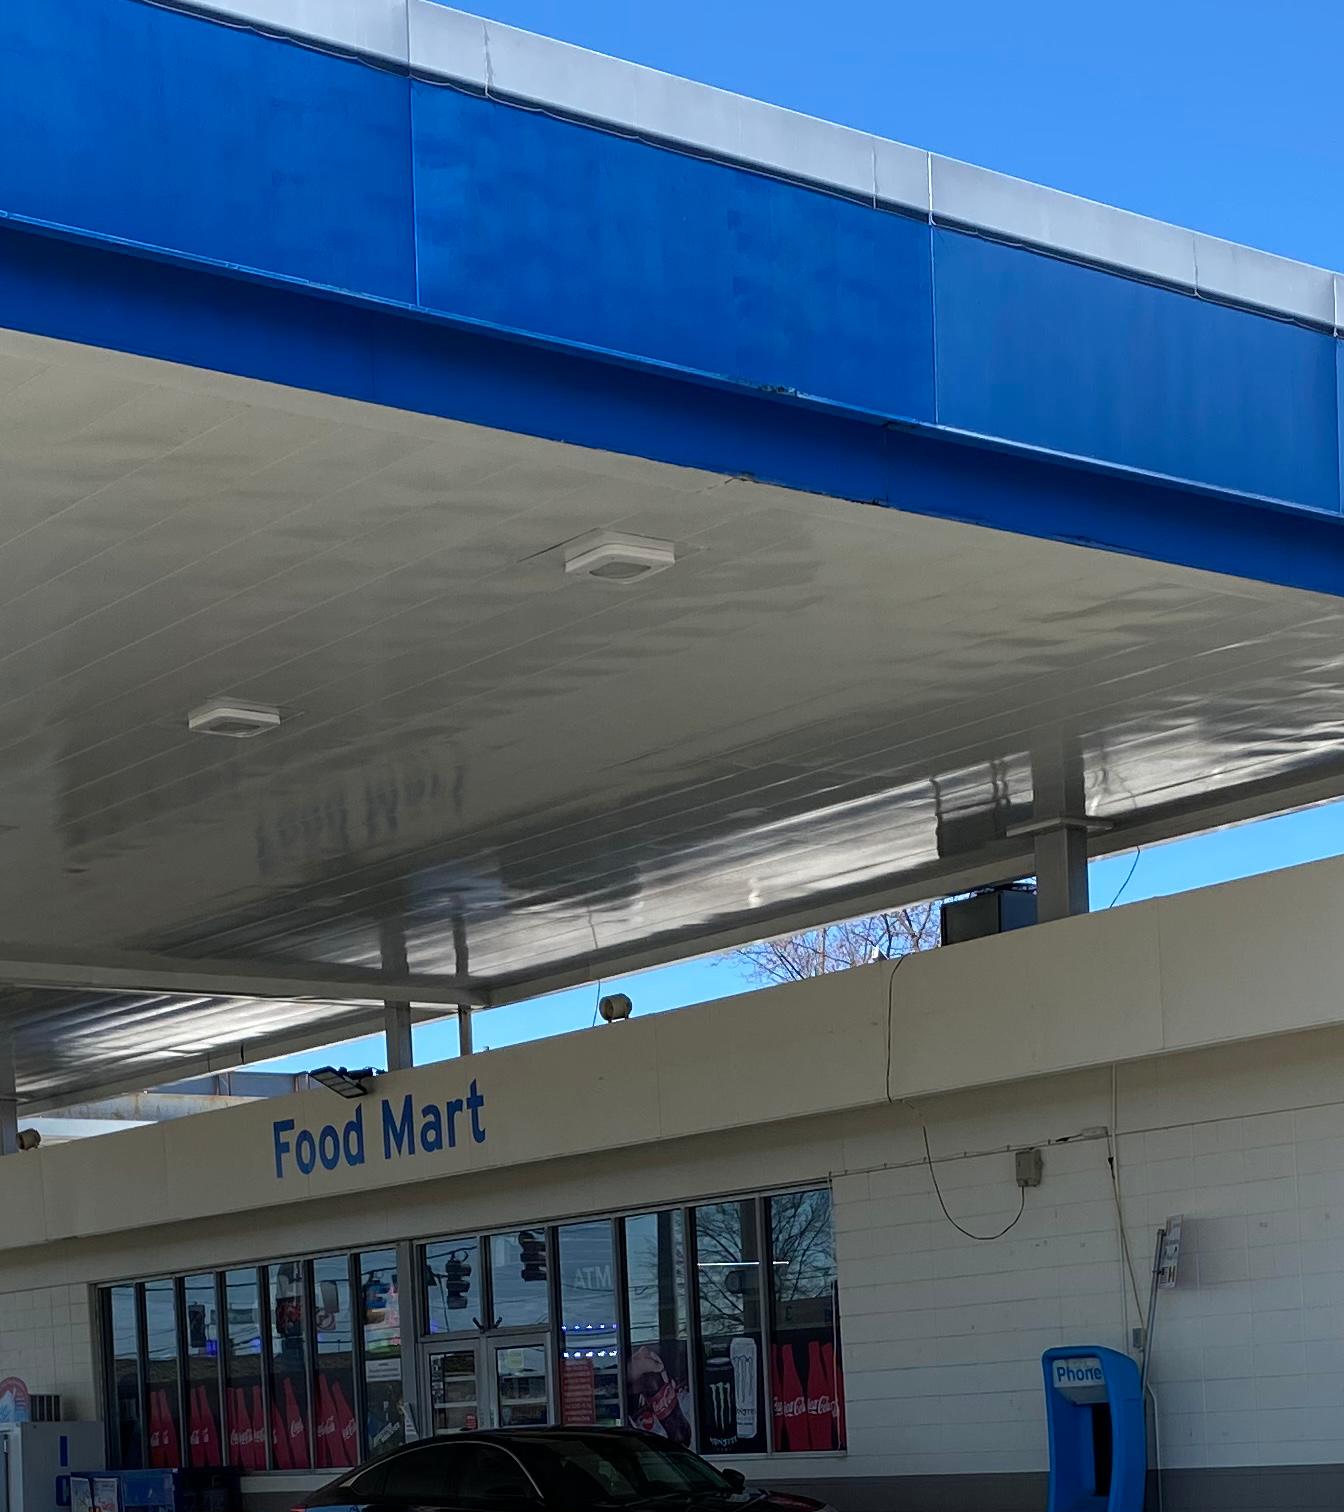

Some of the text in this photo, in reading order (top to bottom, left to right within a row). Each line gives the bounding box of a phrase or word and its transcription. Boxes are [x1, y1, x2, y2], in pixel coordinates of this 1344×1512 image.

[273, 1078, 486, 1179] Food Mart
[575, 1265, 612, 1289] ATM
[1056, 1366, 1102, 1382] Phone
